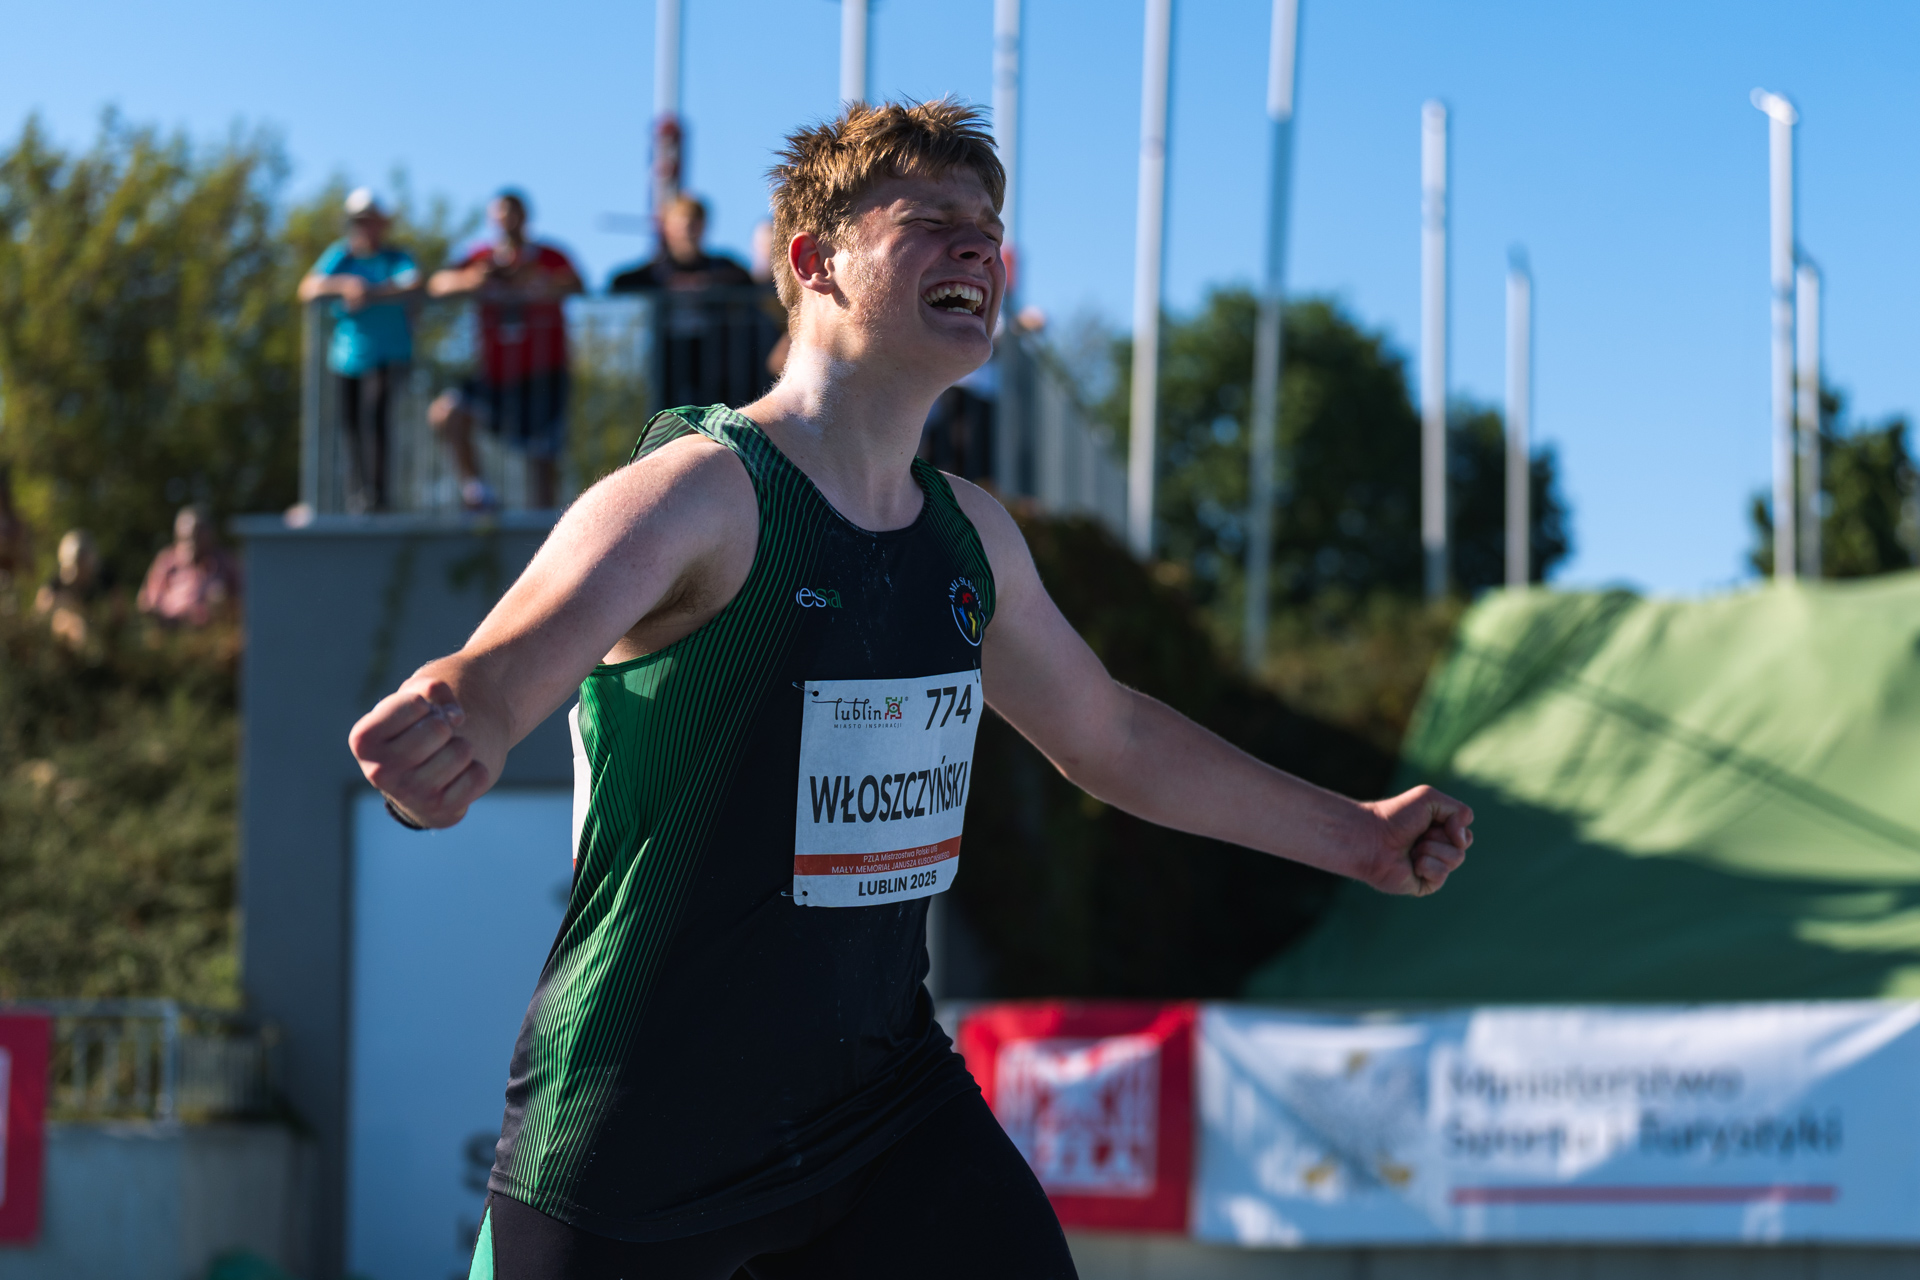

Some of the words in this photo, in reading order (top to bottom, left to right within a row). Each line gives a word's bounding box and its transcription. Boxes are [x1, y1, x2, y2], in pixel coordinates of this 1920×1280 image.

[925, 684, 972, 731] 774
[809, 755, 968, 824] WŁOSZCZYŃSKI
[831, 865, 854, 874] MAŁY
[855, 863, 891, 874] MEMORIAŁ
[891, 859, 917, 870] JANUSZA
[863, 854, 880, 863] PZLA
[880, 850, 915, 862] Mistrzostwa
[858, 876, 908, 896] LUBLIN
[910, 869, 938, 889] 2025
